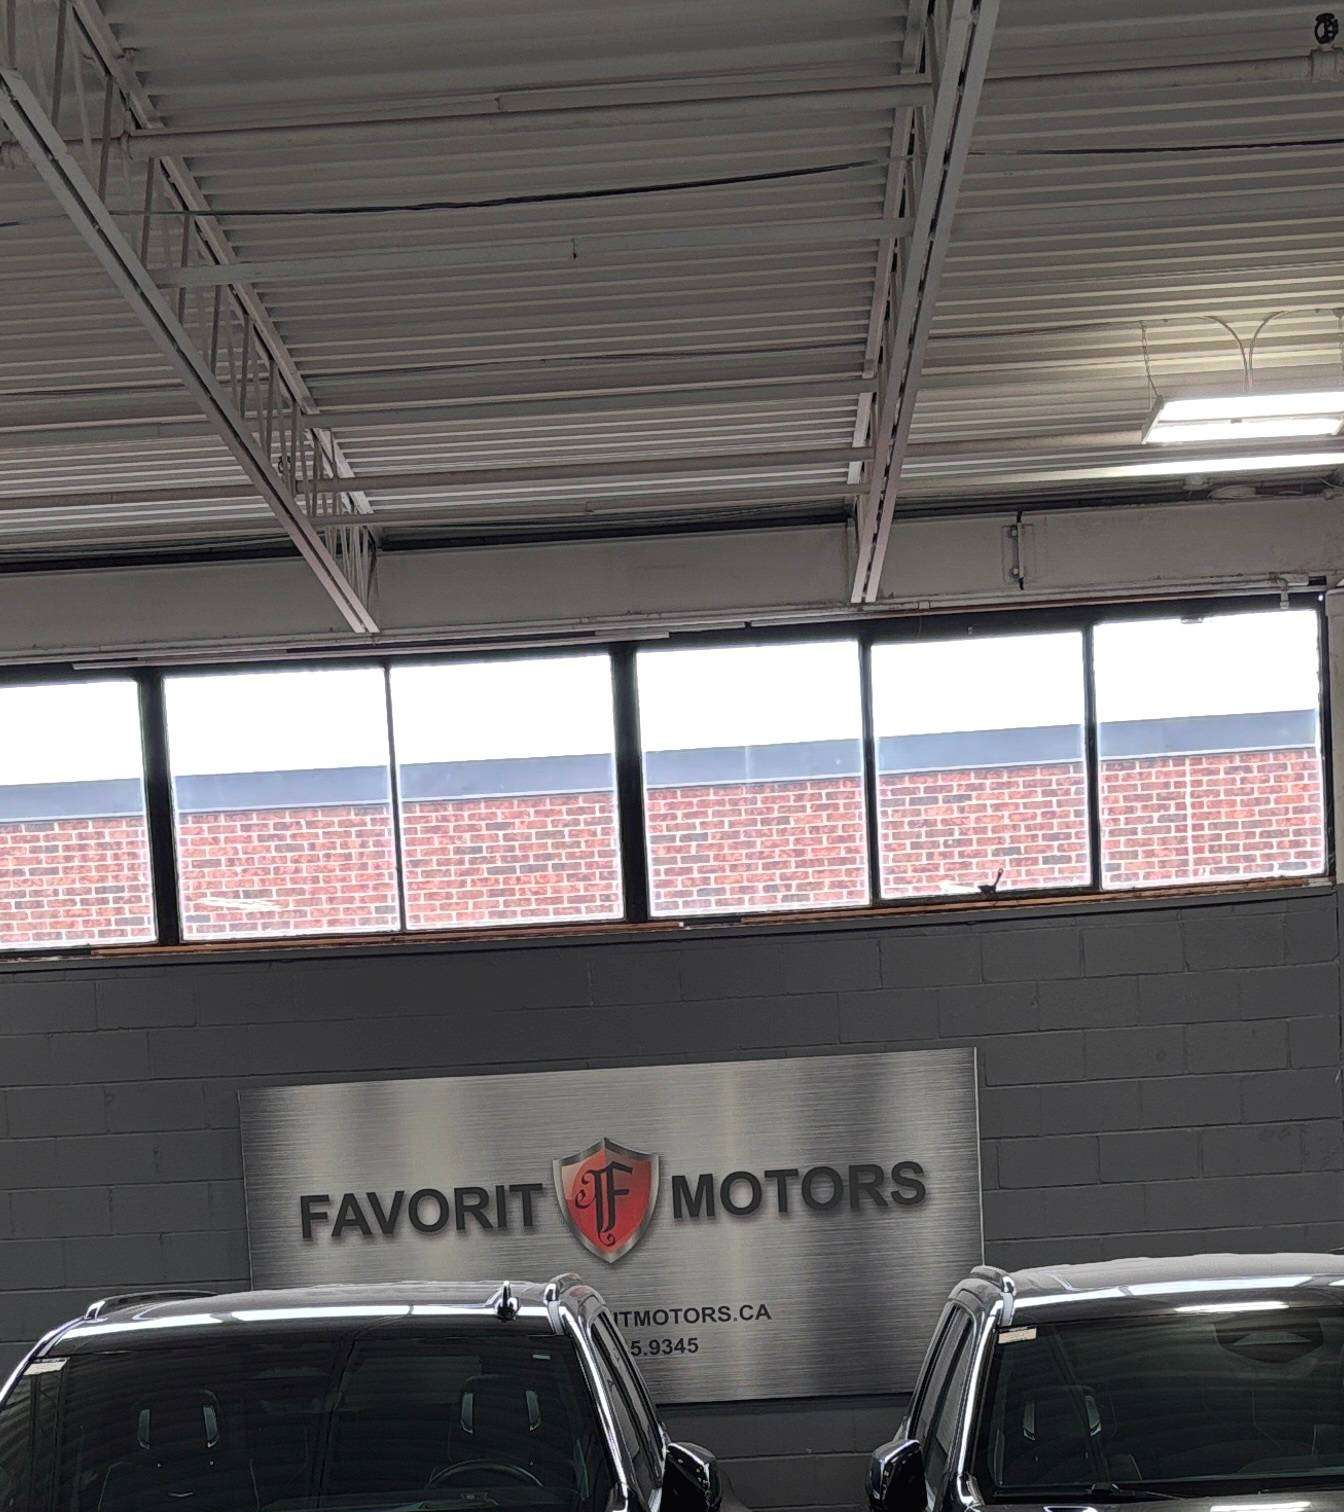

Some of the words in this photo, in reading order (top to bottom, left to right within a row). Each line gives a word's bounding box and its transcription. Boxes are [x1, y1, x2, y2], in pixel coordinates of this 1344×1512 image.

[300, 1183, 543, 1239] FAVORIT
[672, 1160, 926, 1220] MOTORS
[612, 1303, 773, 1328] ITMOTORS.CA
